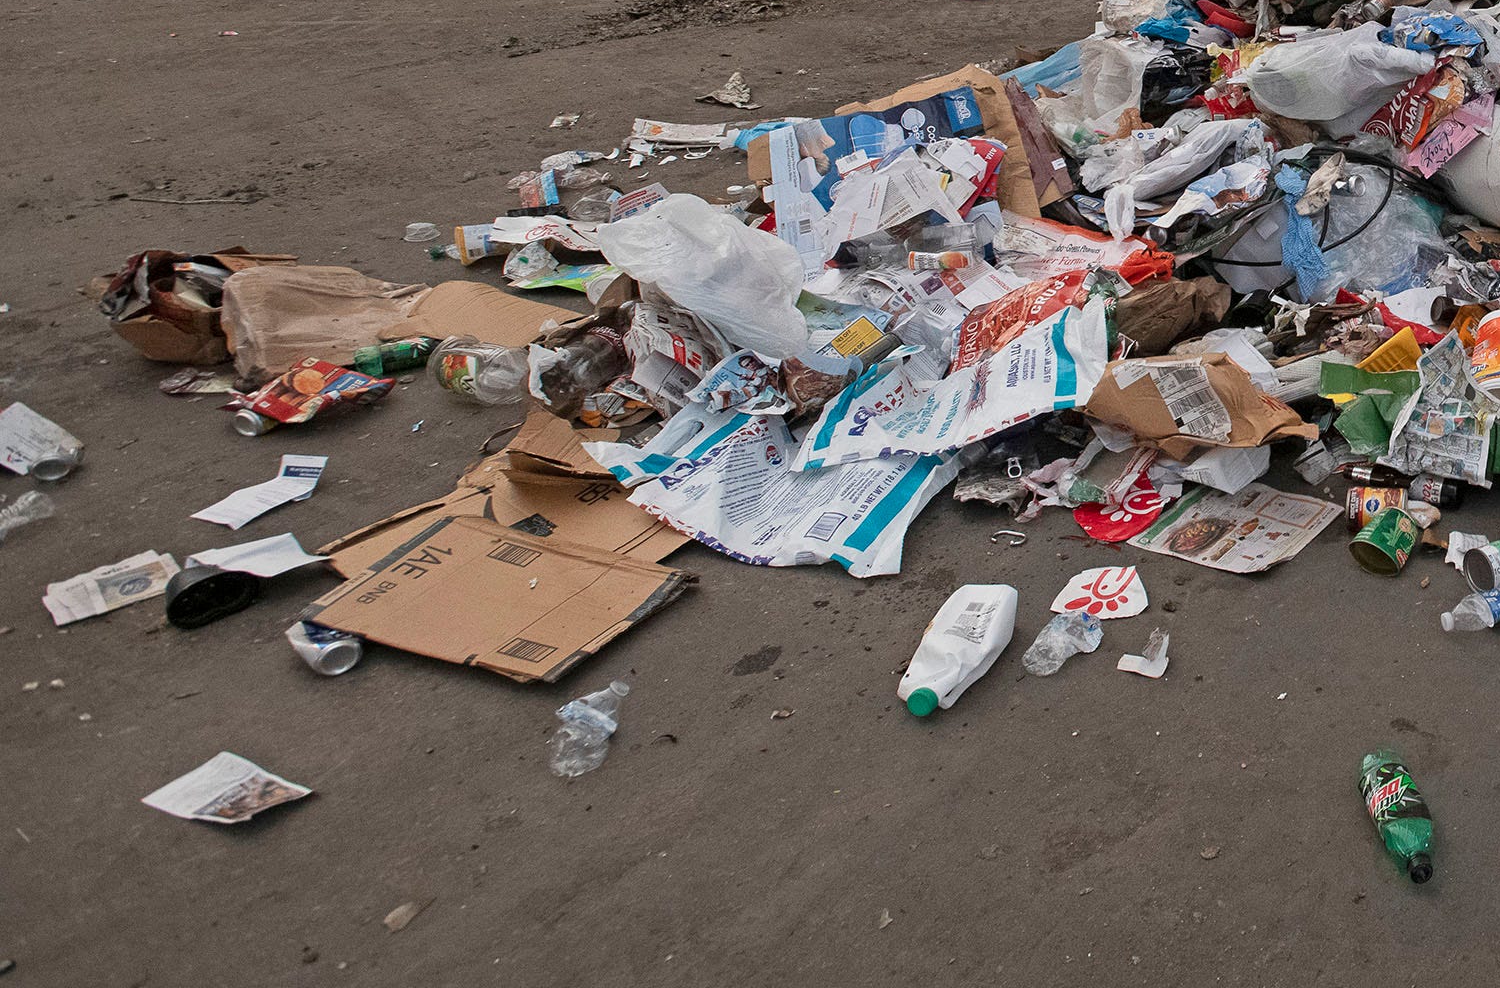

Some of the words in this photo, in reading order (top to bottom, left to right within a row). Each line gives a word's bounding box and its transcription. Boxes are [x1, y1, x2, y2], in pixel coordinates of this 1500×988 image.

[458, 375, 477, 394] V8
[859, 502, 869, 513] LB
[866, 492, 879, 505] NET
[874, 483, 887, 497] WT.
[883, 471, 899, 488] (18.1
[895, 462, 908, 476] kg)
[391, 543, 453, 580] 1AE
[356, 580, 398, 605] BNB
